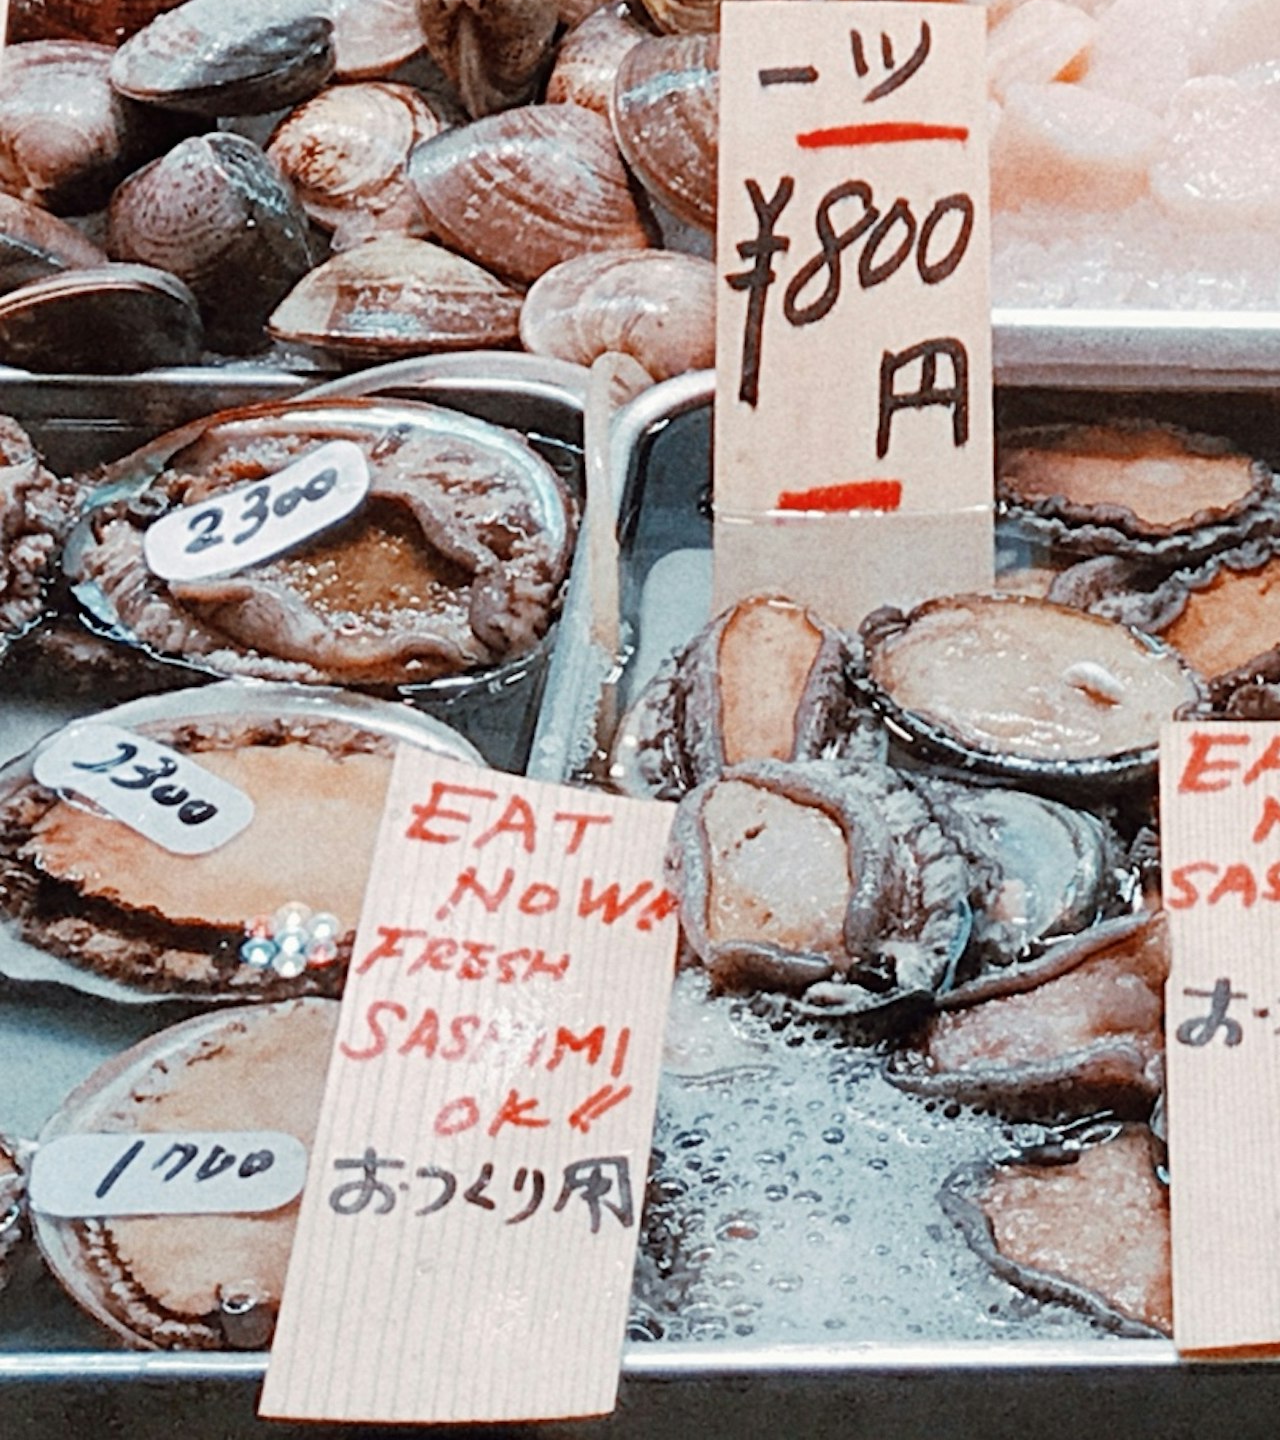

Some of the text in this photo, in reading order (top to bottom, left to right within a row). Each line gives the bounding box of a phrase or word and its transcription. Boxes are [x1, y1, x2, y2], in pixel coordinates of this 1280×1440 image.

[758, 19, 931, 103] 一ツ
[725, 174, 975, 410] ¥800
[875, 336, 969, 459] 円
[183, 467, 339, 555] 2300
[406, 781, 613, 855] EAT
[356, 927, 572, 984] FRESH
